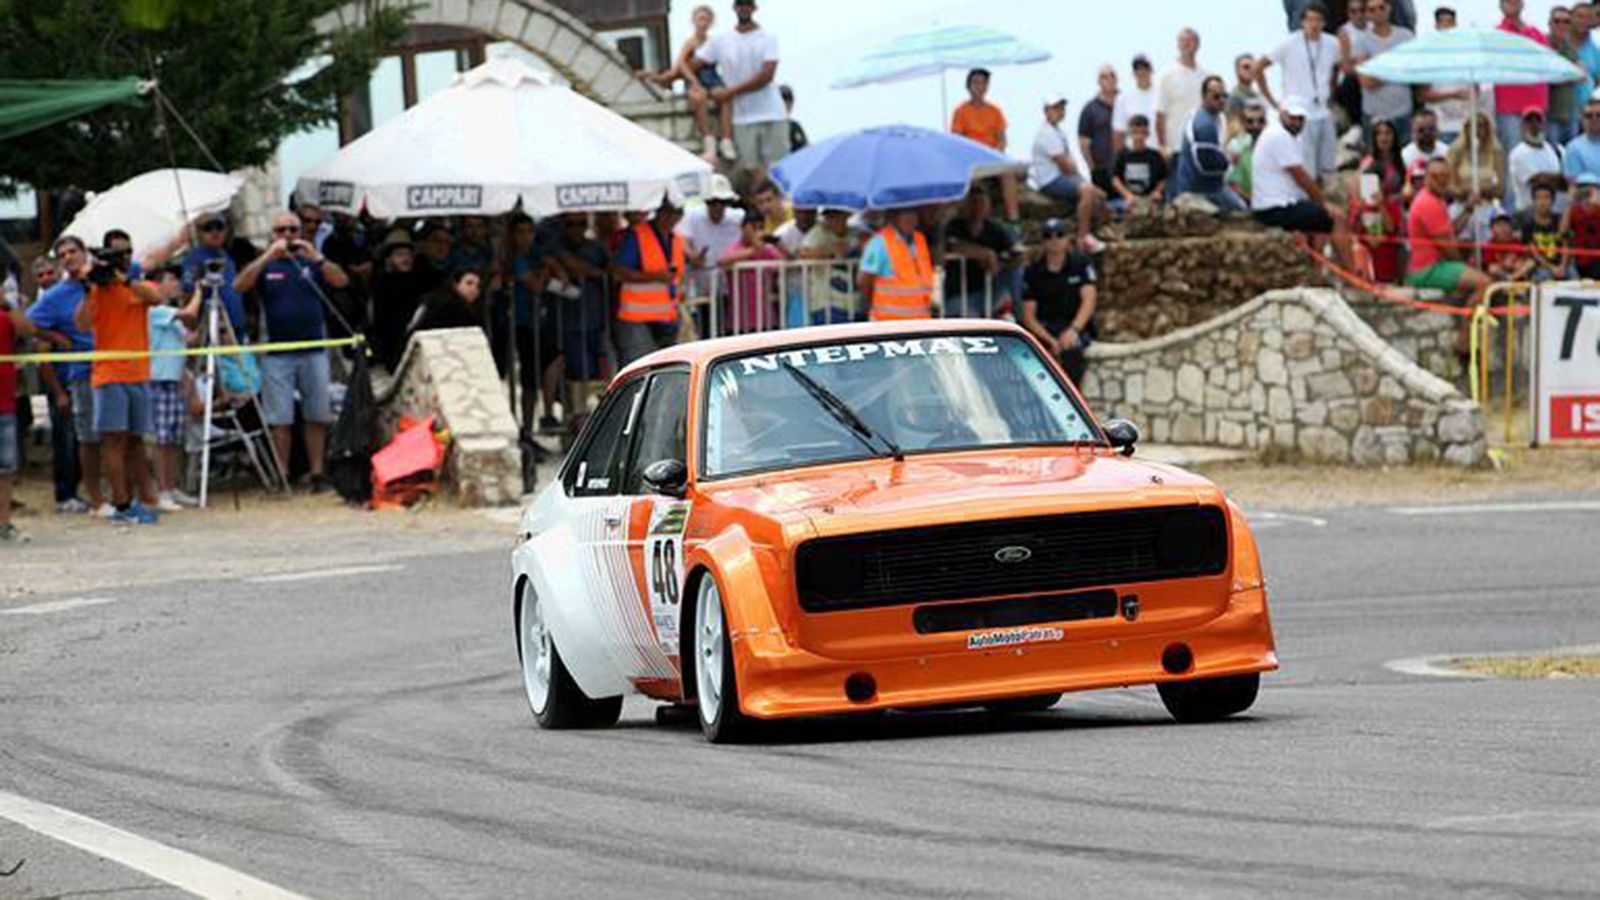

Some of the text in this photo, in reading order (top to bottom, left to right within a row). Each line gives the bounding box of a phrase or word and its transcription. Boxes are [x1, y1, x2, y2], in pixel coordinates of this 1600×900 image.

[411, 187, 479, 206] CAMPARI
[560, 185, 625, 206] CAMPARI
[1553, 297, 1600, 360] T
[739, 337, 998, 374] ΝΤΕΡΜΑΣ
[652, 538, 679, 605] 48
